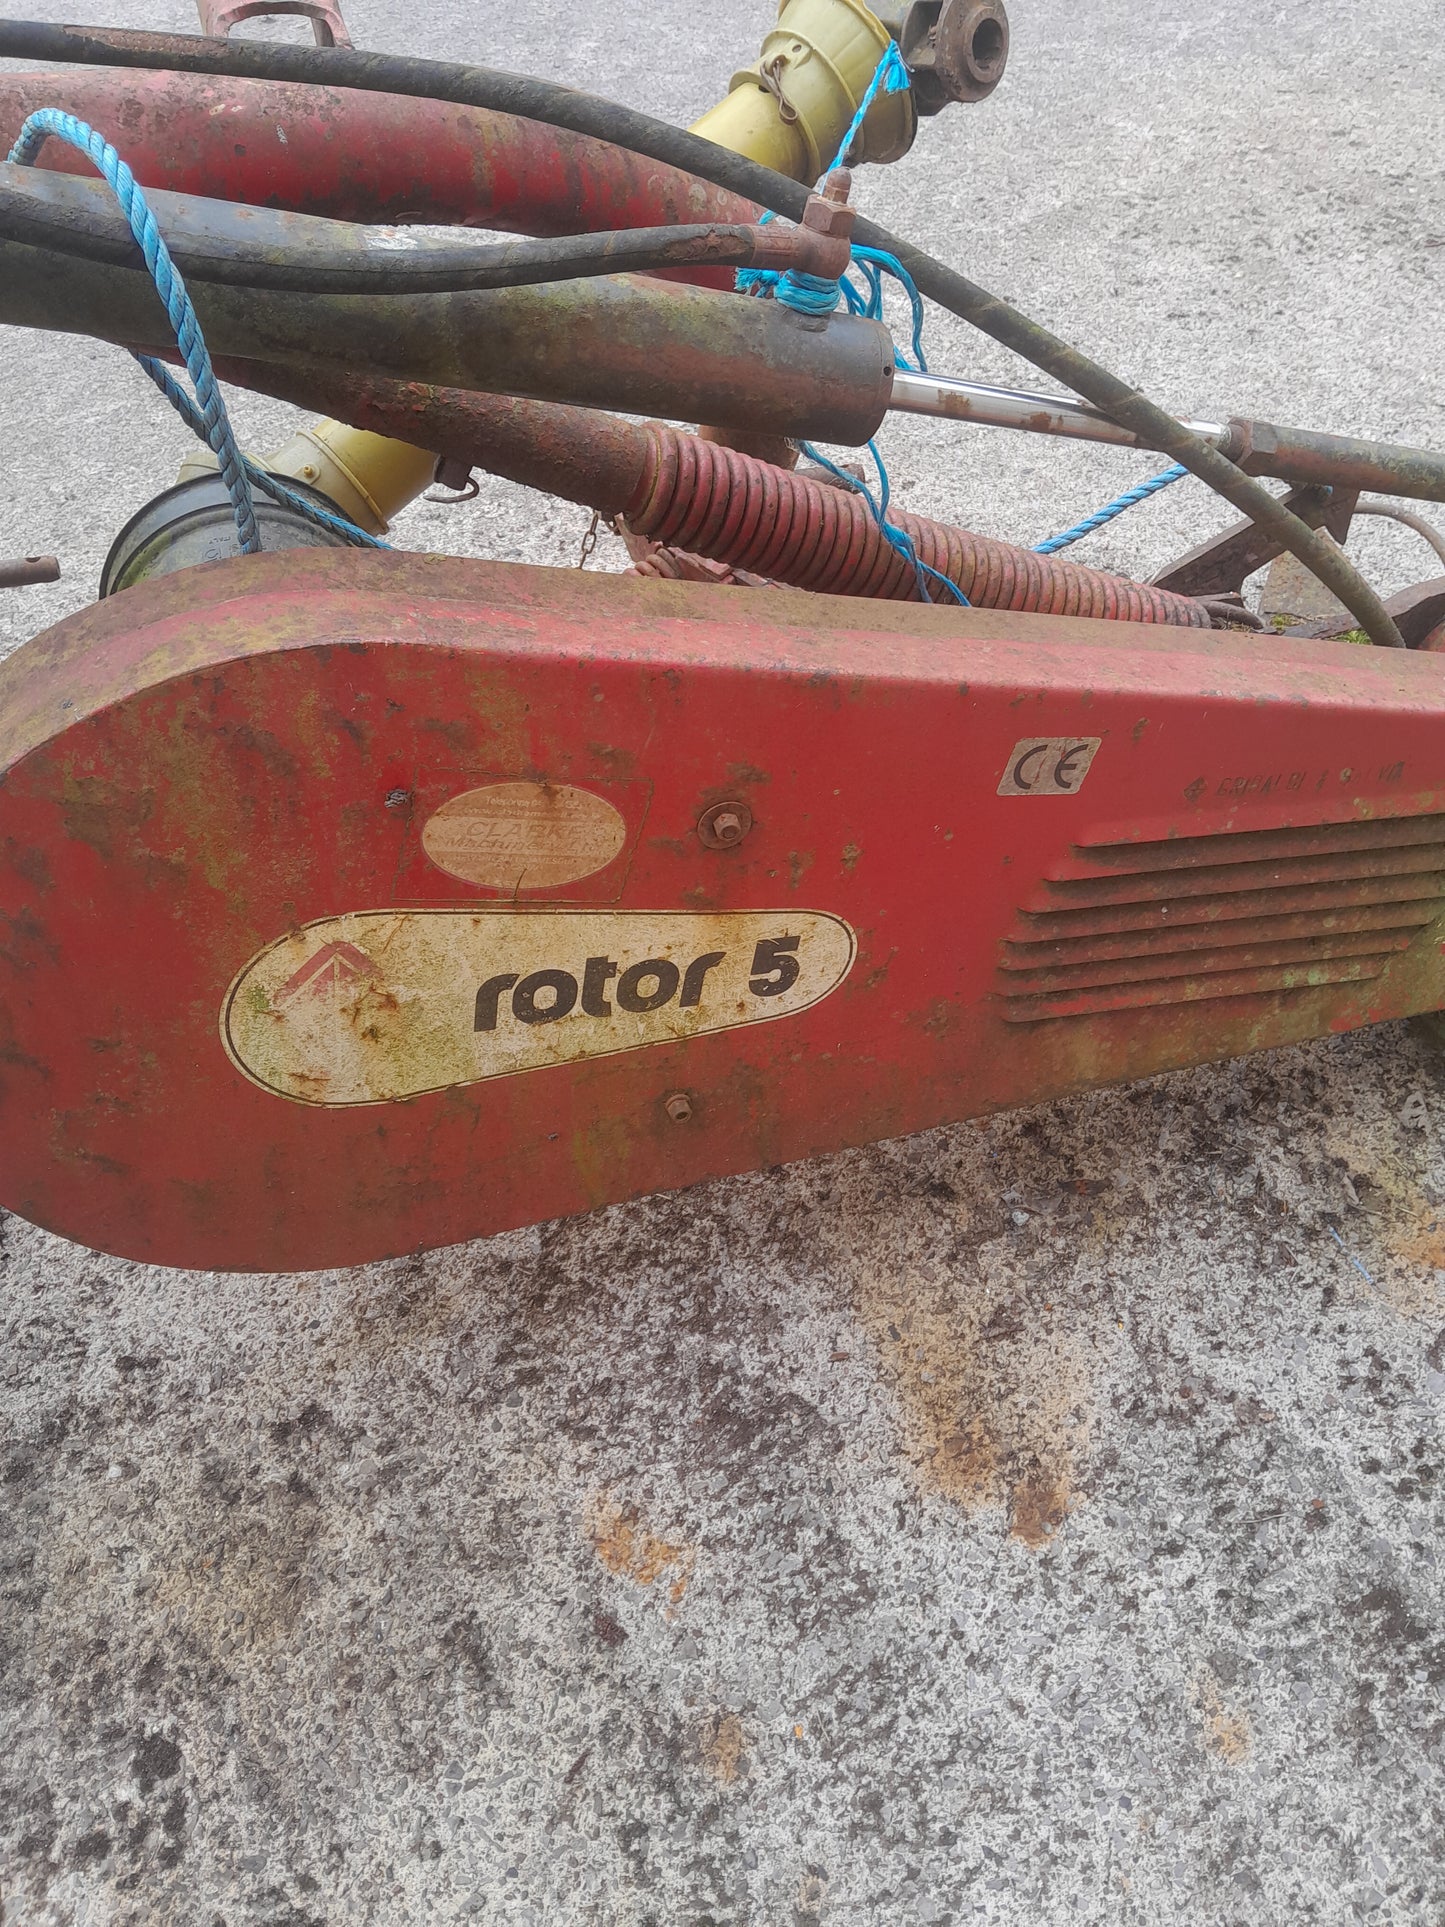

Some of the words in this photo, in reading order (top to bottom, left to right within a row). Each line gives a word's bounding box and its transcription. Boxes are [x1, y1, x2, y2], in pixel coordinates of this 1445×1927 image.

[1013, 744, 1089, 790] CE
[466, 821, 584, 840] CLARKE
[474, 952, 727, 1032] rotor
[748, 936, 801, 997] 5
